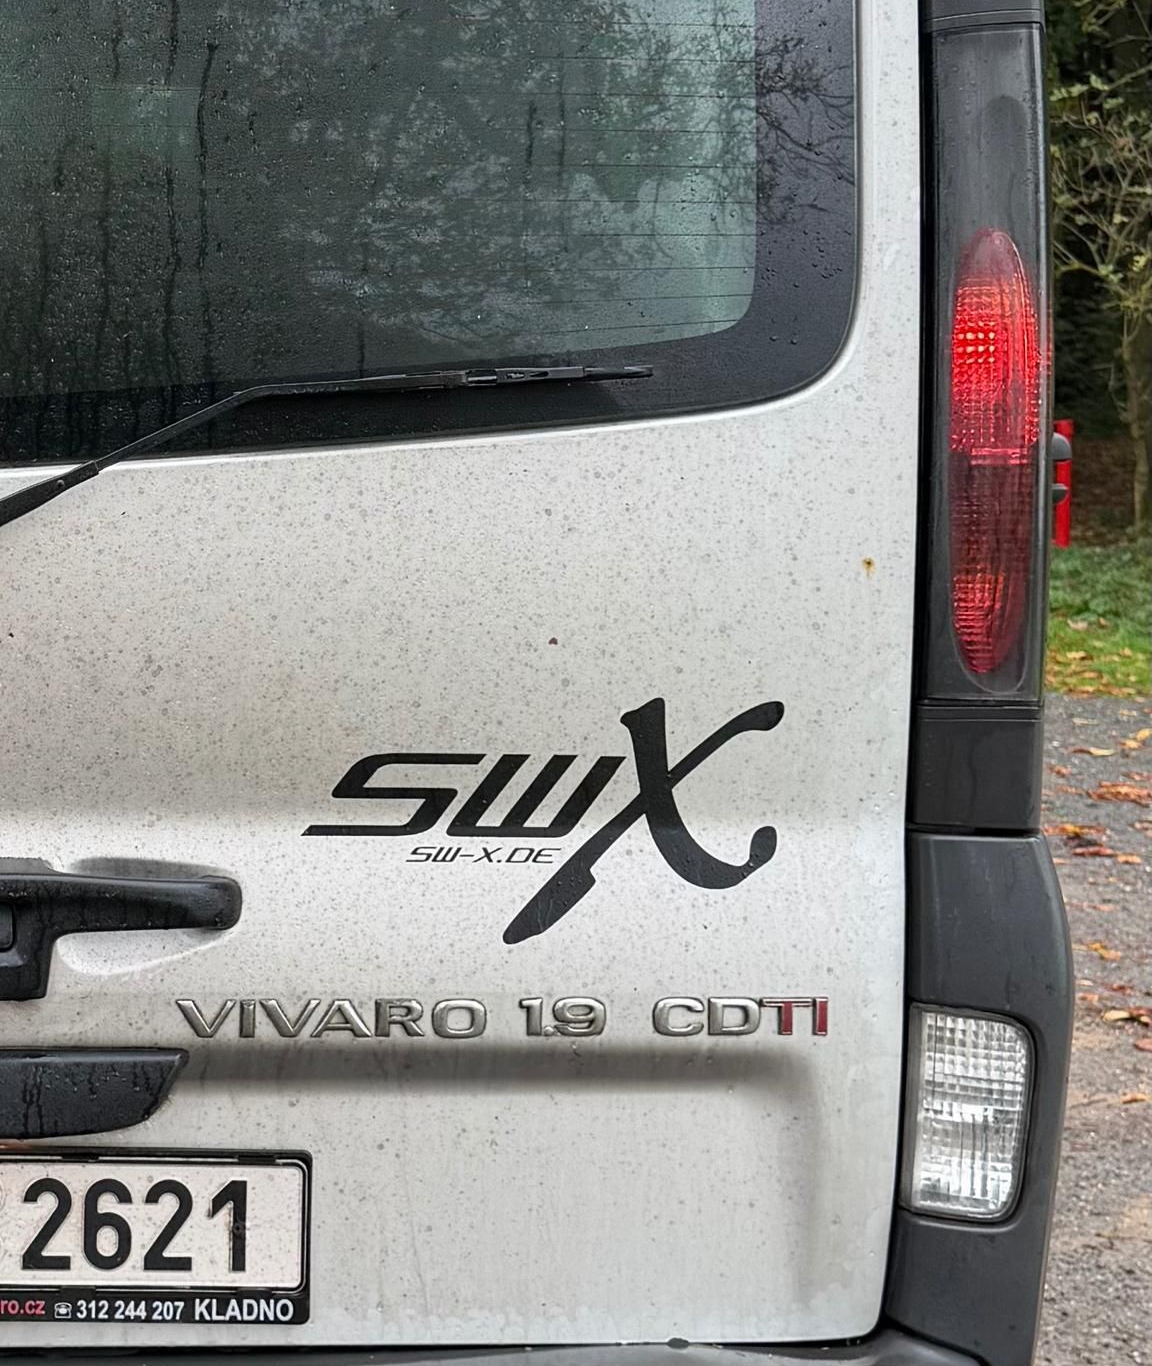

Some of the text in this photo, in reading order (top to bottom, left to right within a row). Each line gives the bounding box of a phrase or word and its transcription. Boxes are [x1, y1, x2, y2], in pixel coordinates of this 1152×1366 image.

[405, 846, 562, 863] SW-X.DE
[176, 997, 488, 1038] VIVARO
[652, 996, 831, 1036] CDTI
[21, 1178, 249, 1272] 2621
[76, 1300, 109, 1319] 312
[114, 1301, 147, 1320] 244
[152, 1301, 185, 1321] 207
[194, 1299, 294, 1322] KLADNO
